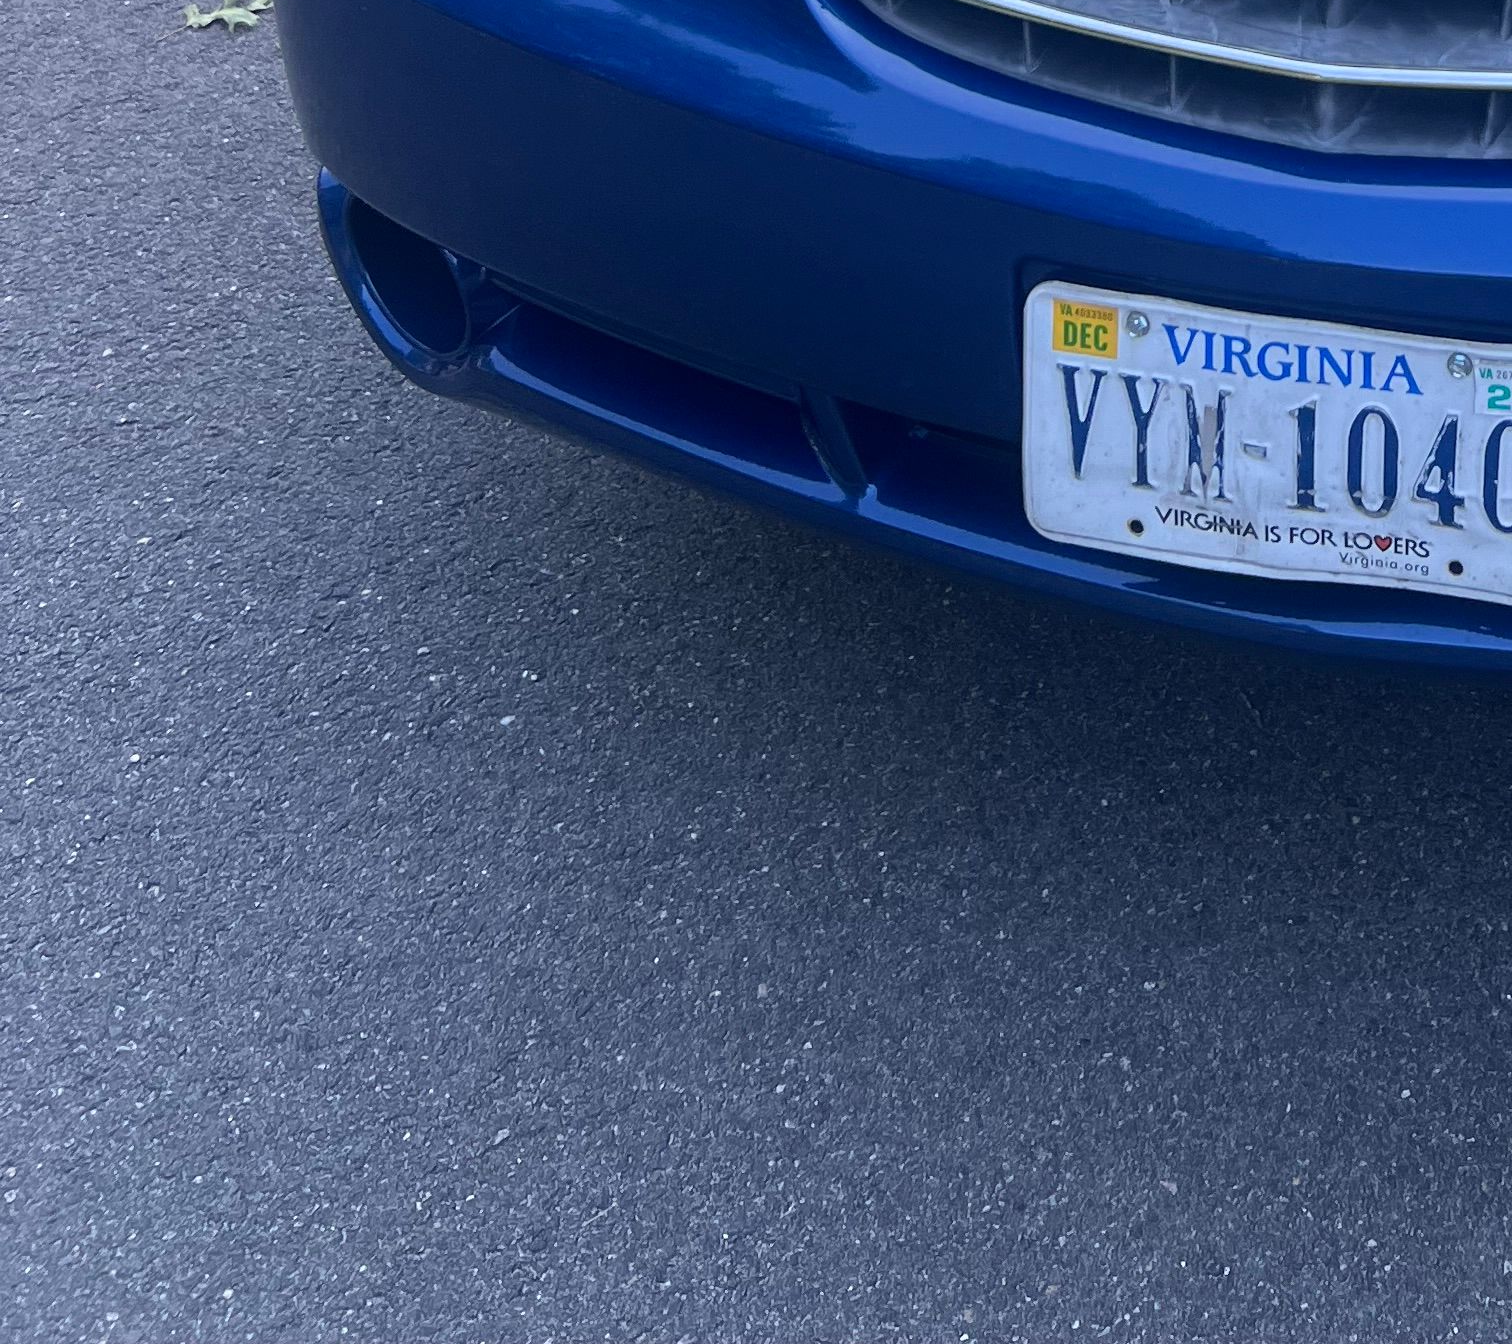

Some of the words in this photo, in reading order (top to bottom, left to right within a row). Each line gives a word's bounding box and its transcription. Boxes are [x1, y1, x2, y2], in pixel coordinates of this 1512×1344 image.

[1060, 303, 1072, 316] VA
[1063, 320, 1108, 352] DEC
[1161, 322, 1424, 396] VIRGINIA
[1479, 367, 1493, 380] VA
[1154, 505, 1258, 541] VIRGINIA
[1264, 524, 1282, 544] IS
[1289, 526, 1337, 548] FOR
